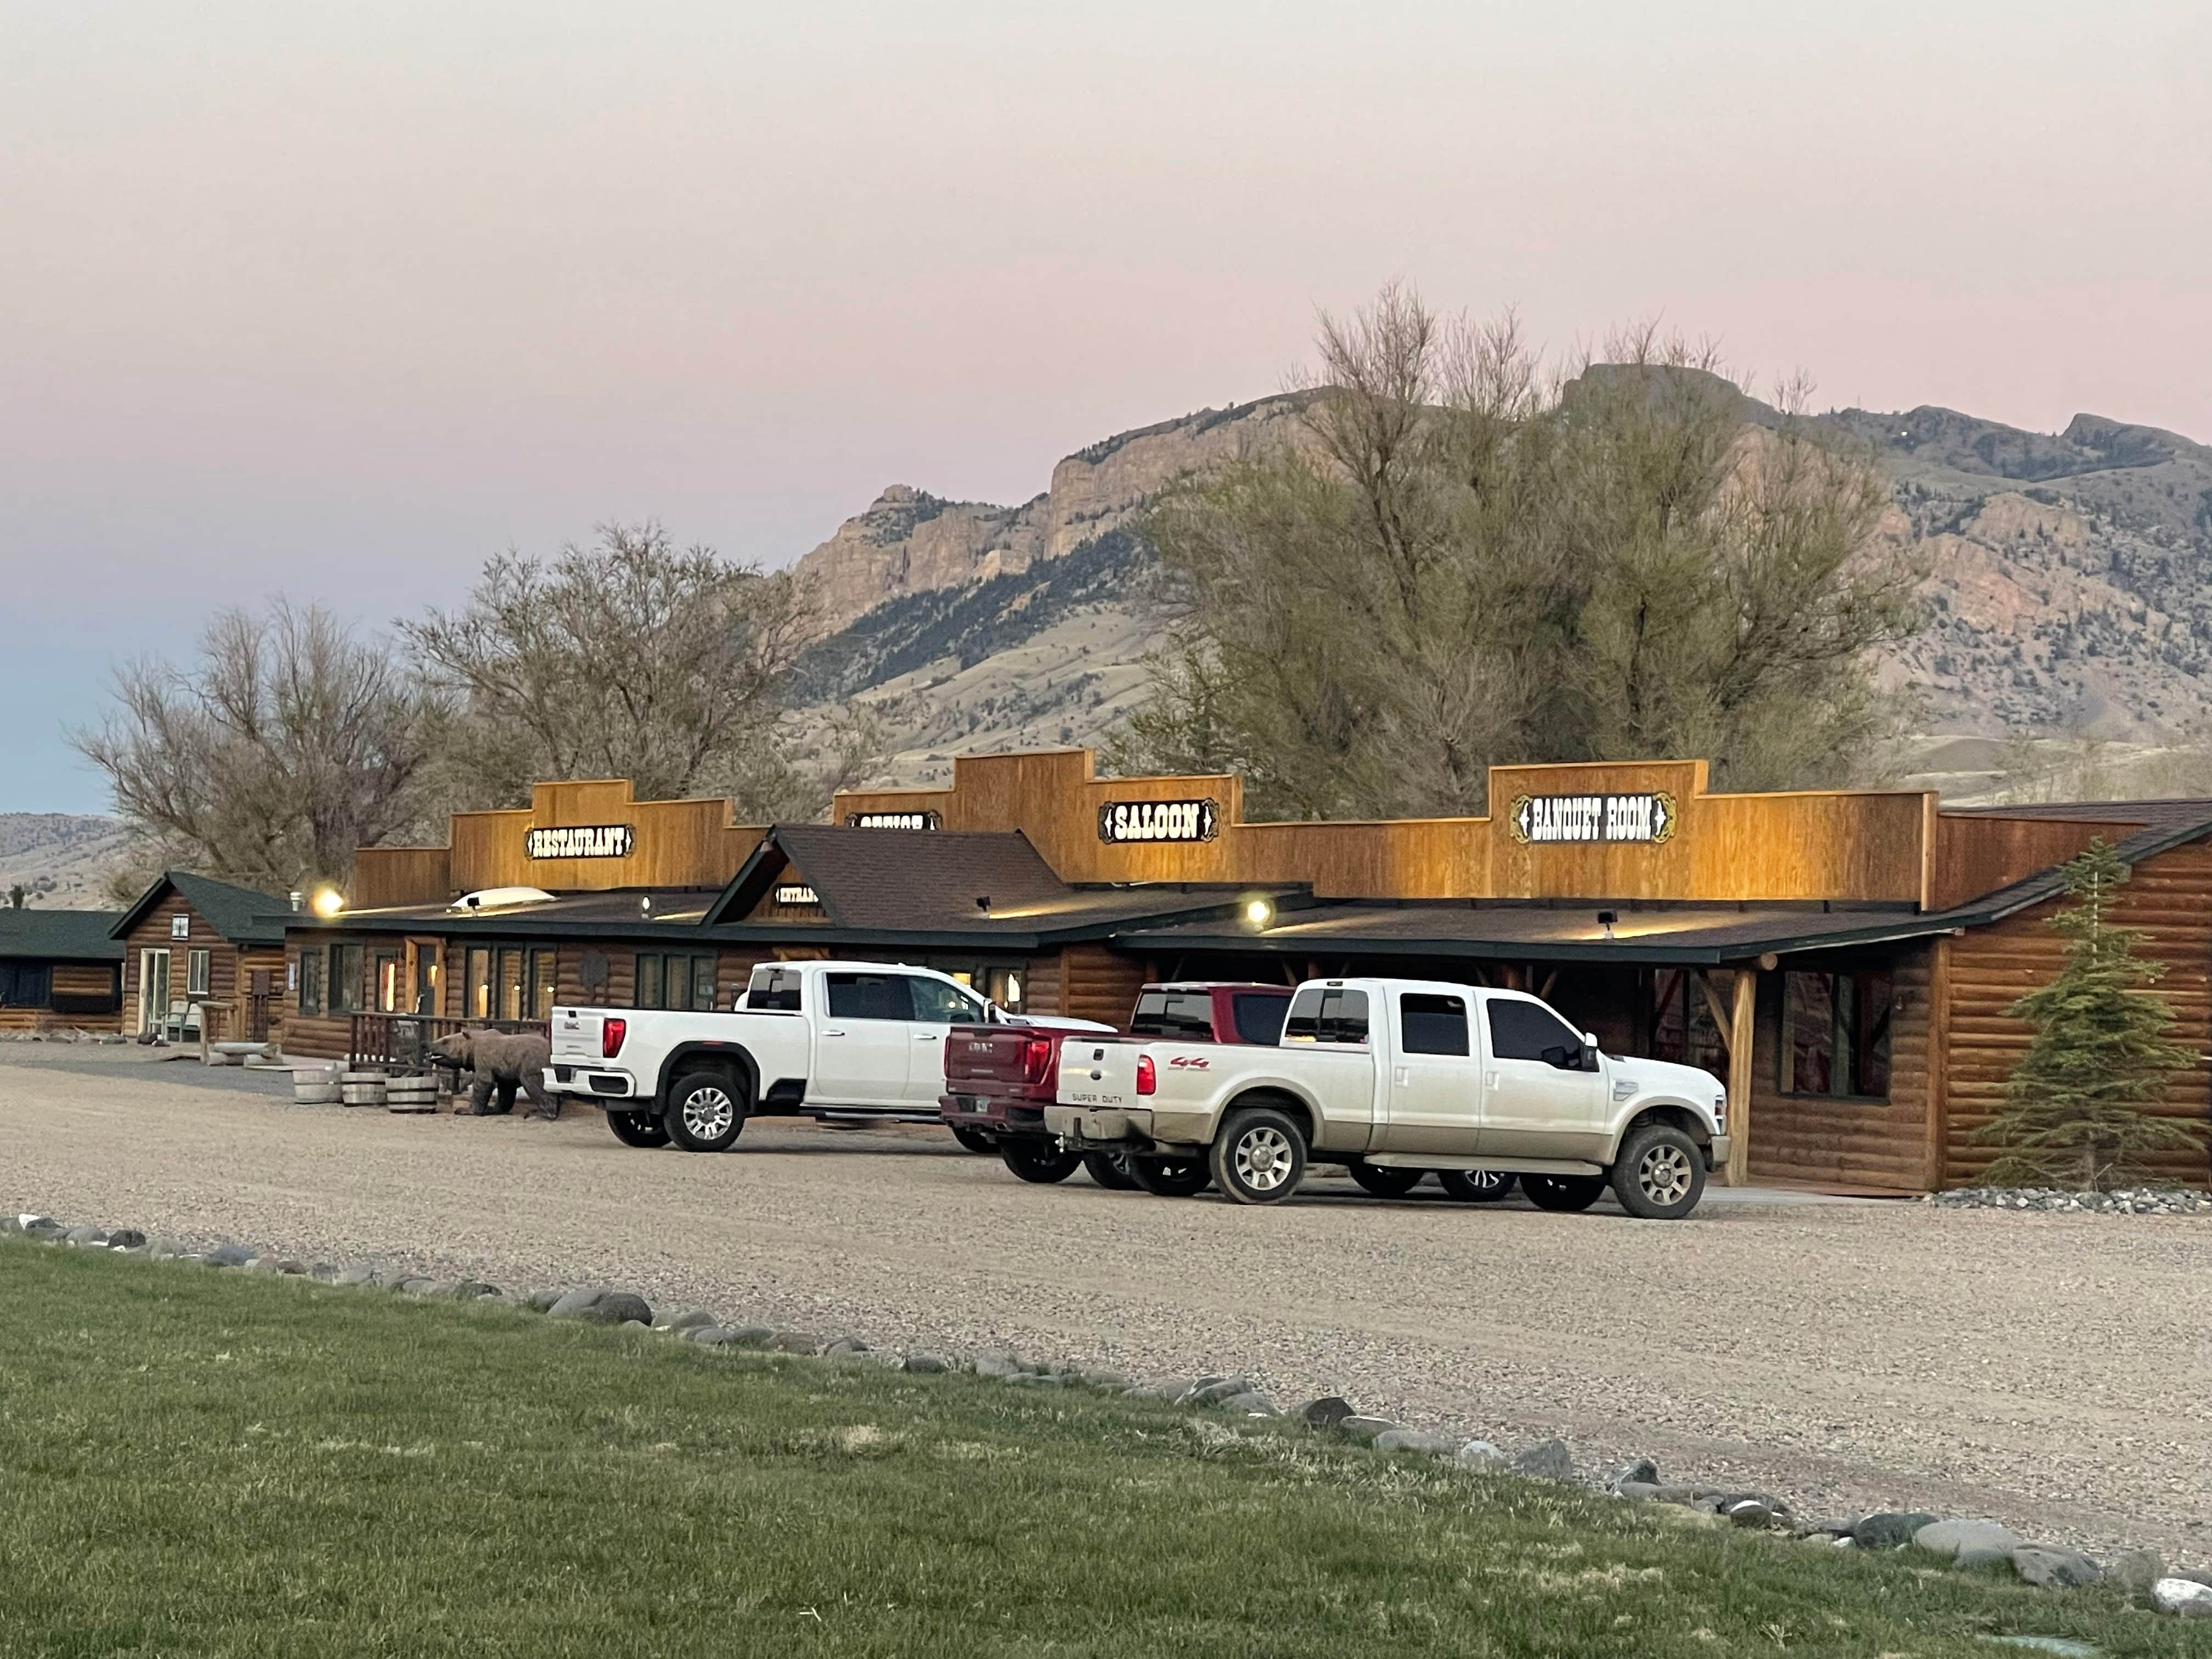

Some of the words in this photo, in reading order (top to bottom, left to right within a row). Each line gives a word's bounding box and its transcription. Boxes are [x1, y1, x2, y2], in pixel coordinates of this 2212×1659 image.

[1114, 803, 1200, 839] SALOON
[1532, 797, 1602, 840] BANQUET
[1606, 796, 1652, 840] ROOM
[533, 827, 625, 857] RESTAURANT
[1072, 1093, 1097, 1102] SUPER
[1102, 1095, 1122, 1103] DUTY
